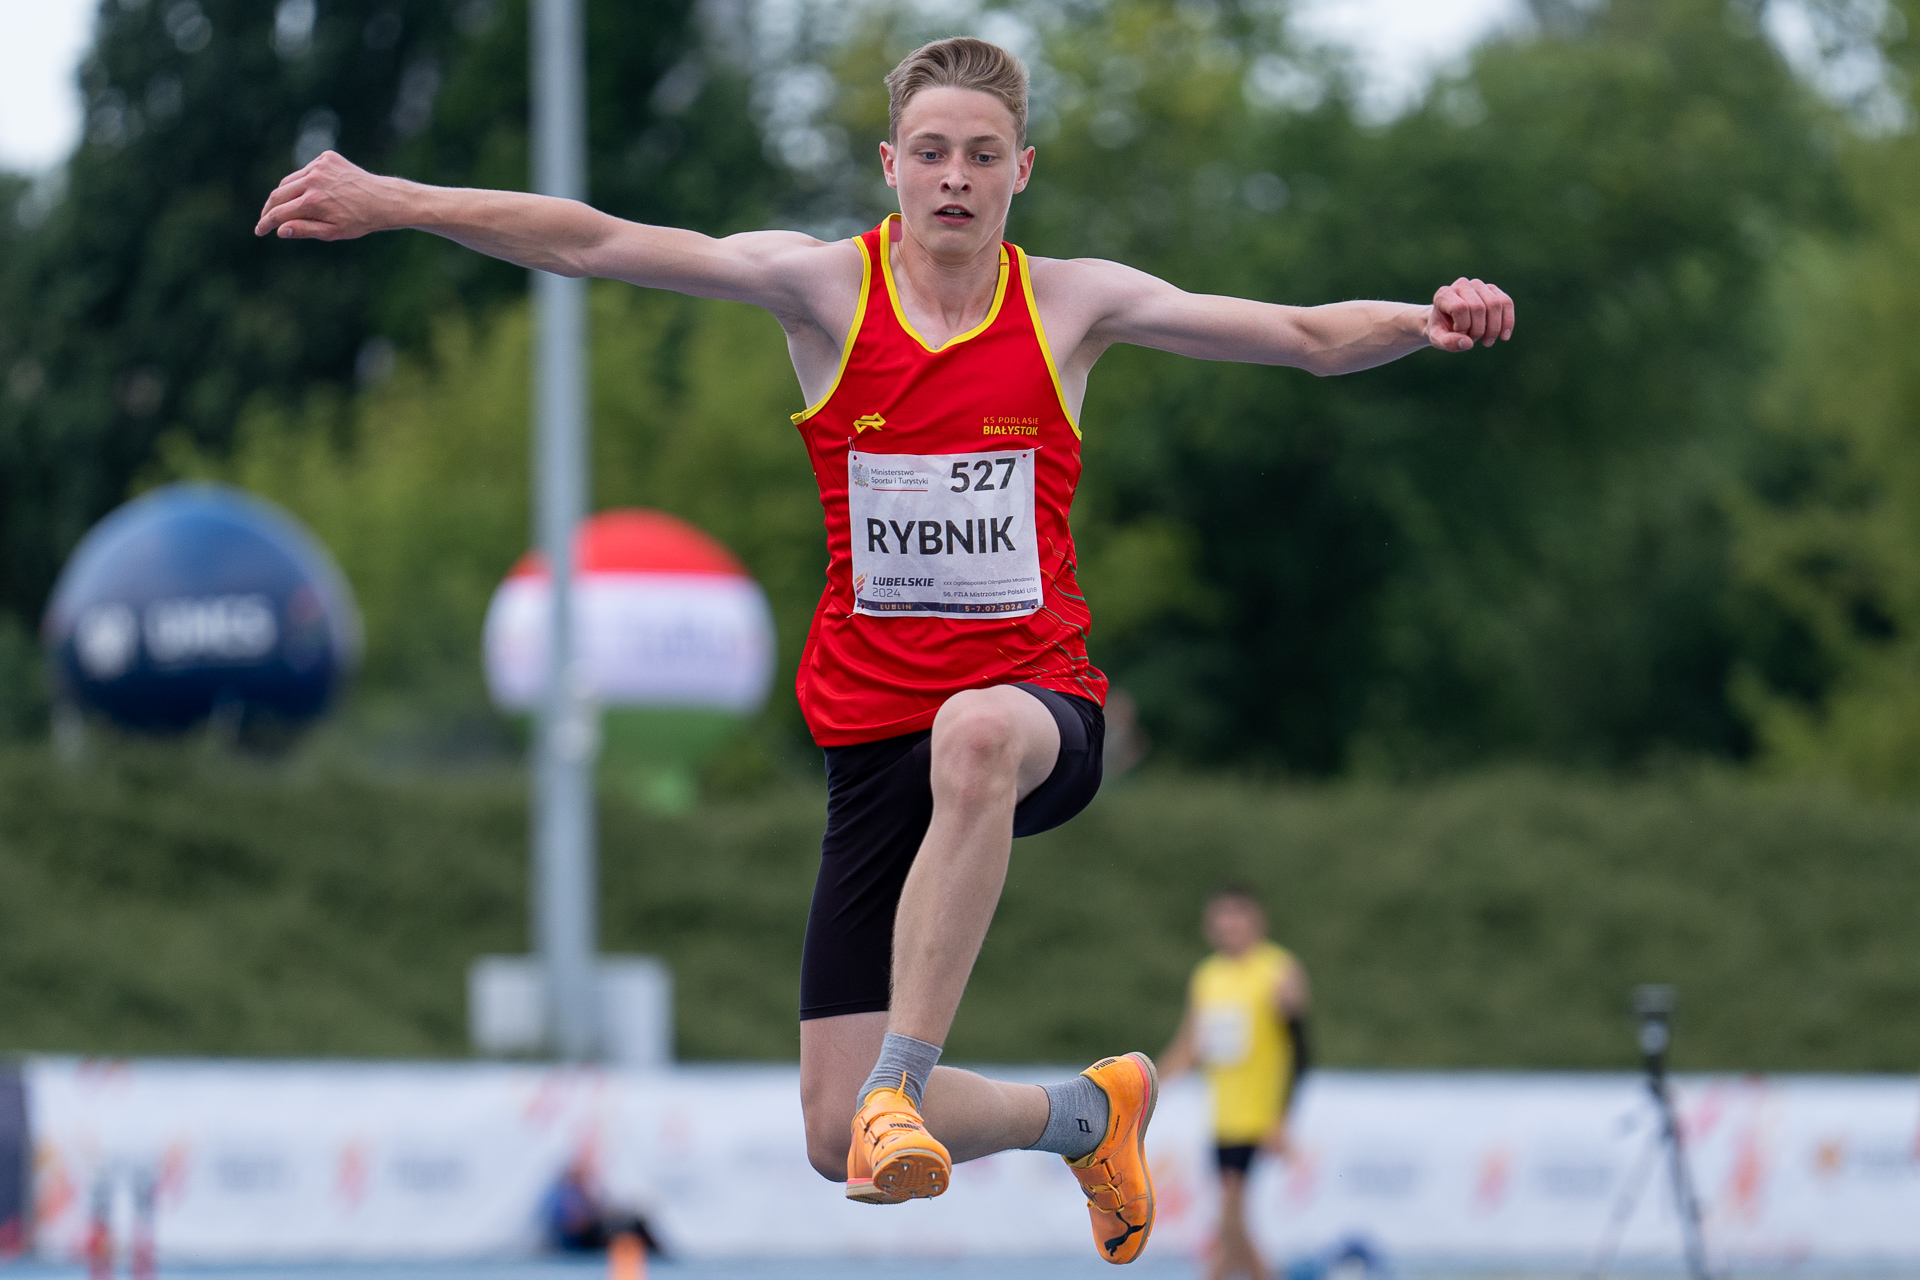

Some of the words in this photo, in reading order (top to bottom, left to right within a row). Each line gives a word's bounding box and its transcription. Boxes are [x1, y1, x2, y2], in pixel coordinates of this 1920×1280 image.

[983, 416, 995, 424] KS
[998, 416, 1039, 425] PODLASIE
[983, 425, 1038, 436] BIAŁYSTOK
[871, 468, 914, 476] Ministerstwo
[950, 457, 1016, 493] 527
[871, 476, 893, 485] Sportu
[898, 477, 929, 486] Turystyki
[867, 515, 1017, 555] RYBNIK
[872, 576, 935, 587] LUBELSKIE
[872, 587, 901, 598] 2024
[969, 590, 1006, 598] Mistrzostwa
[1007, 587, 1026, 596] Polski
[880, 603, 912, 611] LUBLIN
[964, 603, 1023, 612] 5-7.07.2024
[1093, 1058, 1117, 1071] PUMA
